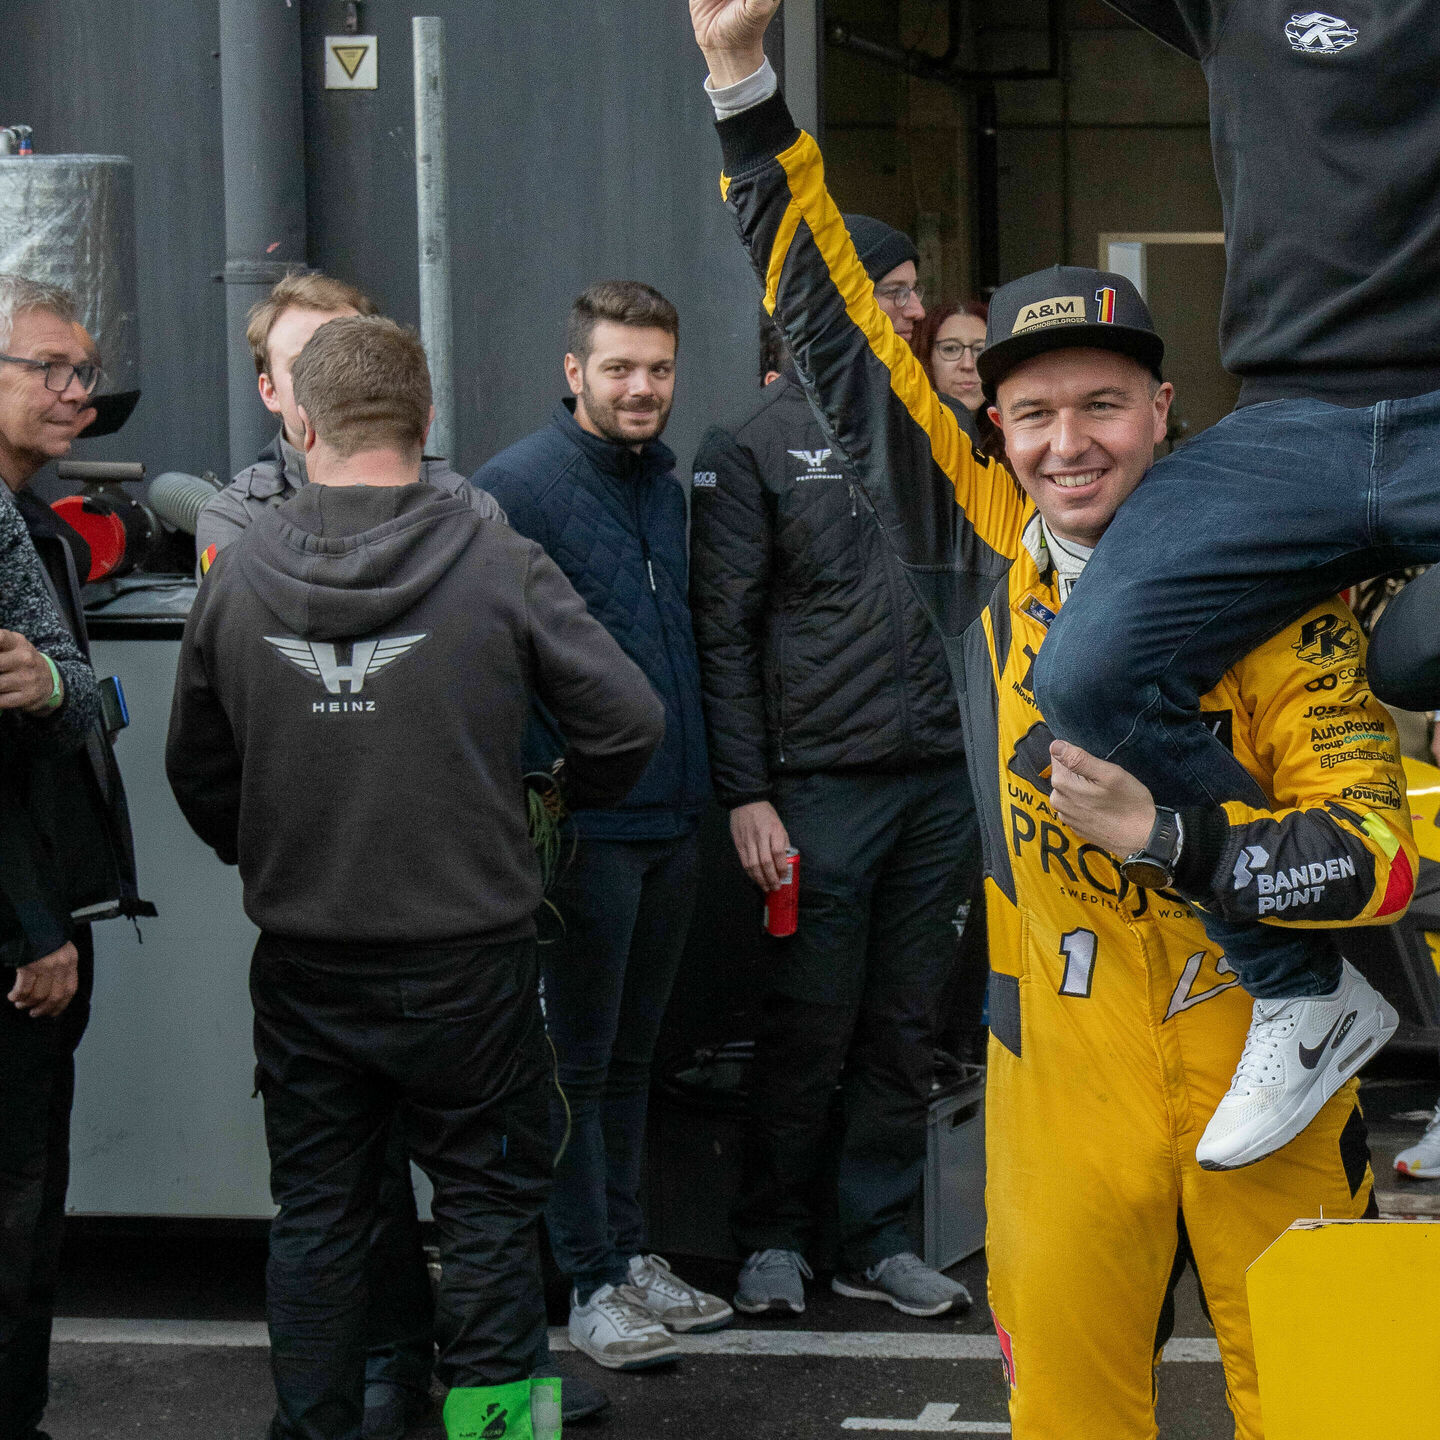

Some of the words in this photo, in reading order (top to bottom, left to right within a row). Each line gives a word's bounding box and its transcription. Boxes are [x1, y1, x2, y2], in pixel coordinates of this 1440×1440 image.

[1024, 301, 1075, 323] A&M
[1094, 286, 1117, 325] 1
[312, 701, 376, 713] HEINZ
[1310, 720, 1385, 743] AutoRepair
[1312, 740, 1344, 753] Group
[1008, 783, 1034, 806] UW
[1256, 855, 1357, 896] BANDEN
[1257, 885, 1326, 916] PUNT
[1058, 926, 1099, 999] 1
